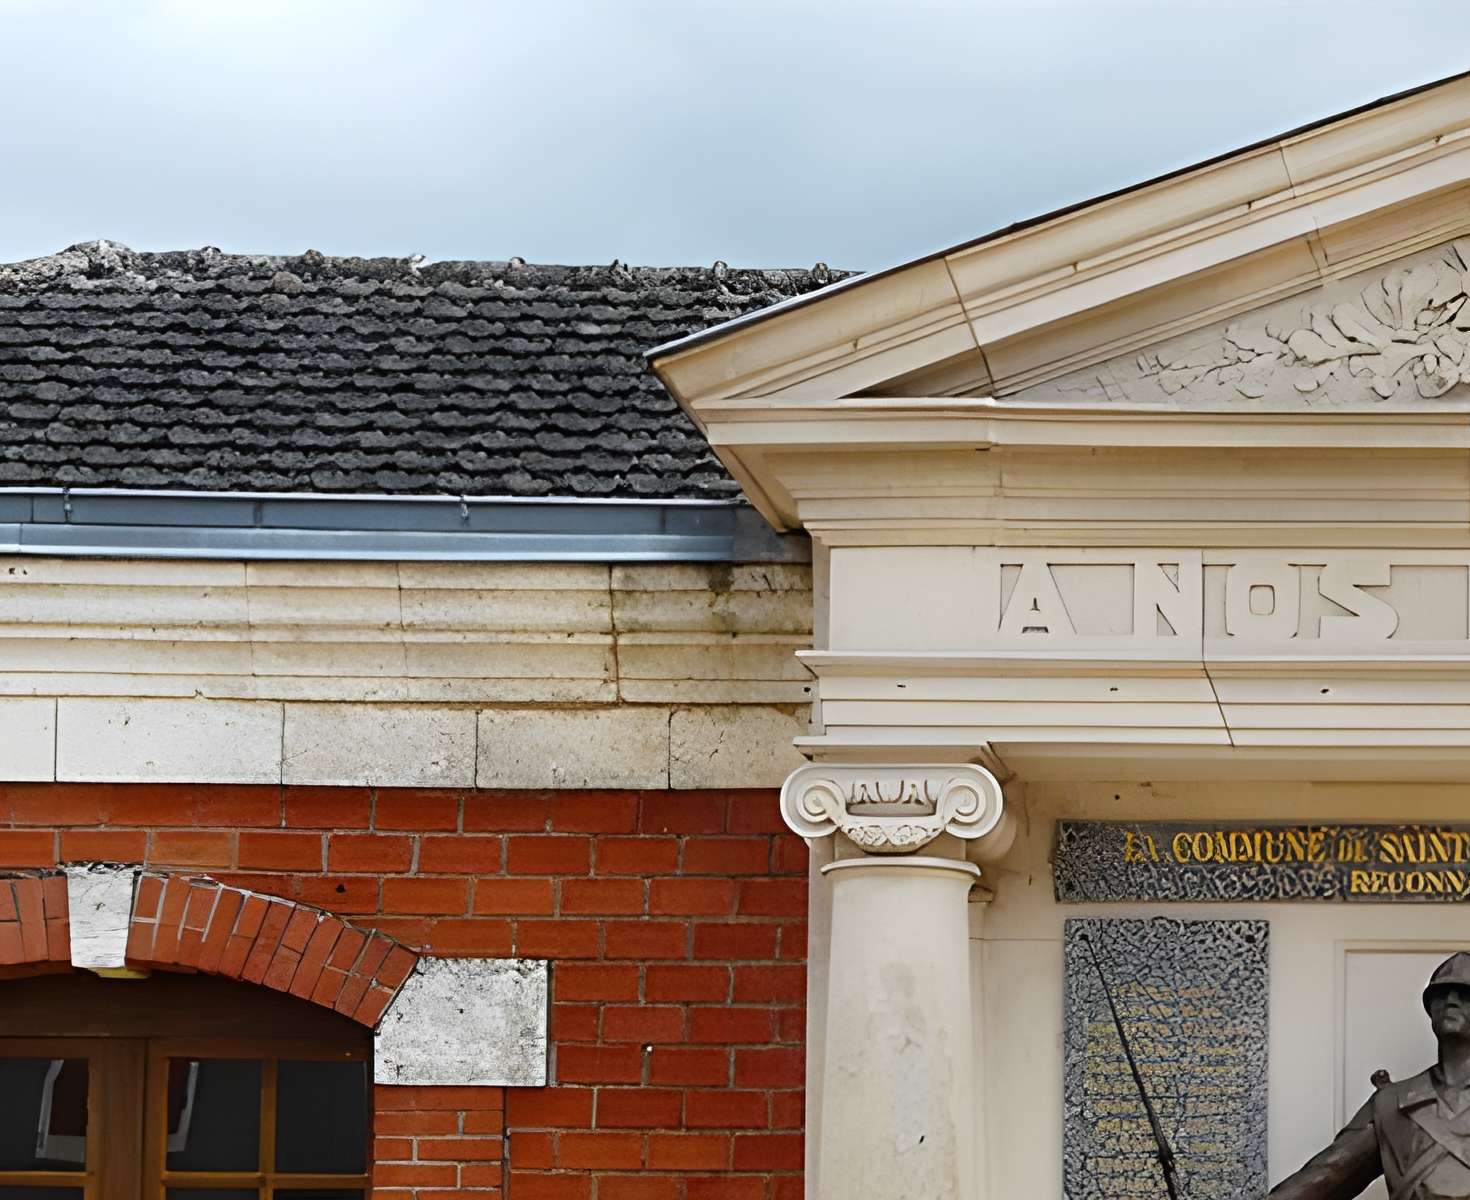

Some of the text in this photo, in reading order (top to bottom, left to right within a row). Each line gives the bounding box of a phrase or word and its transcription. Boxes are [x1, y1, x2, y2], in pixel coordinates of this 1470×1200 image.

[998, 564, 1077, 637] A
[1133, 564, 1400, 638] NOS
[1172, 831, 1326, 864] COMMUNE
